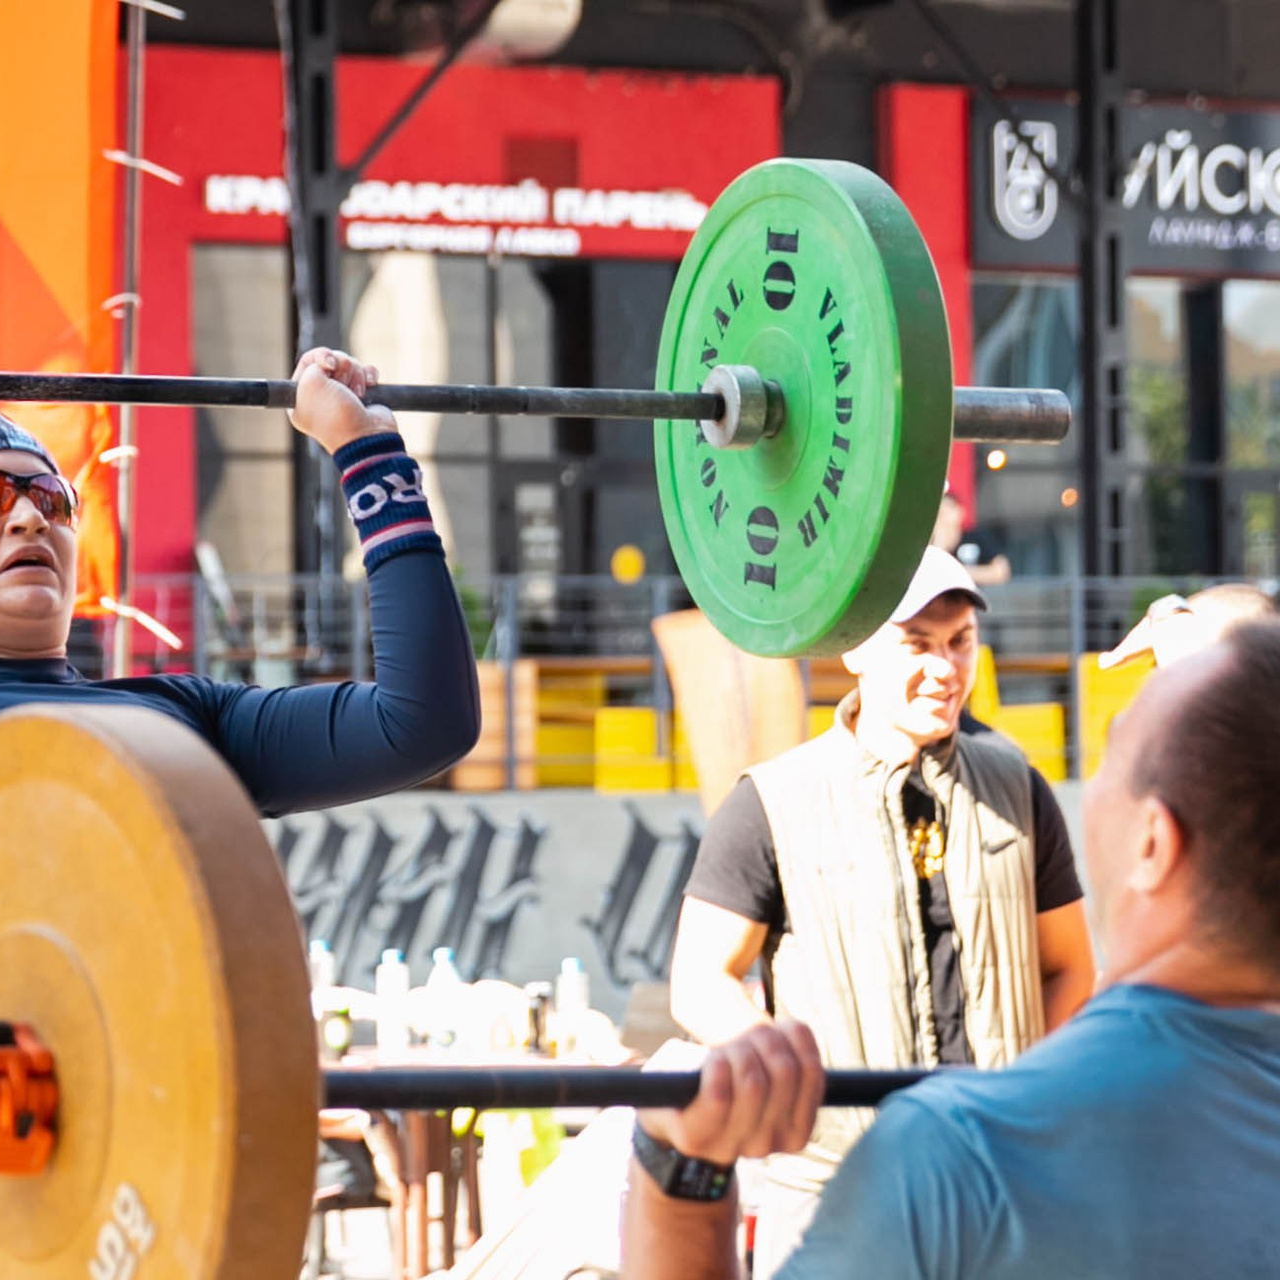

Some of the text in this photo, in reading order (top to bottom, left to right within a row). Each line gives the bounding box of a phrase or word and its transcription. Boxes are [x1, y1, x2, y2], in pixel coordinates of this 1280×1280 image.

[762, 225, 800, 312] 10
[694, 276, 746, 528] NONAL
[797, 286, 854, 549] VLADIMIR
[743, 505, 780, 592] 10
